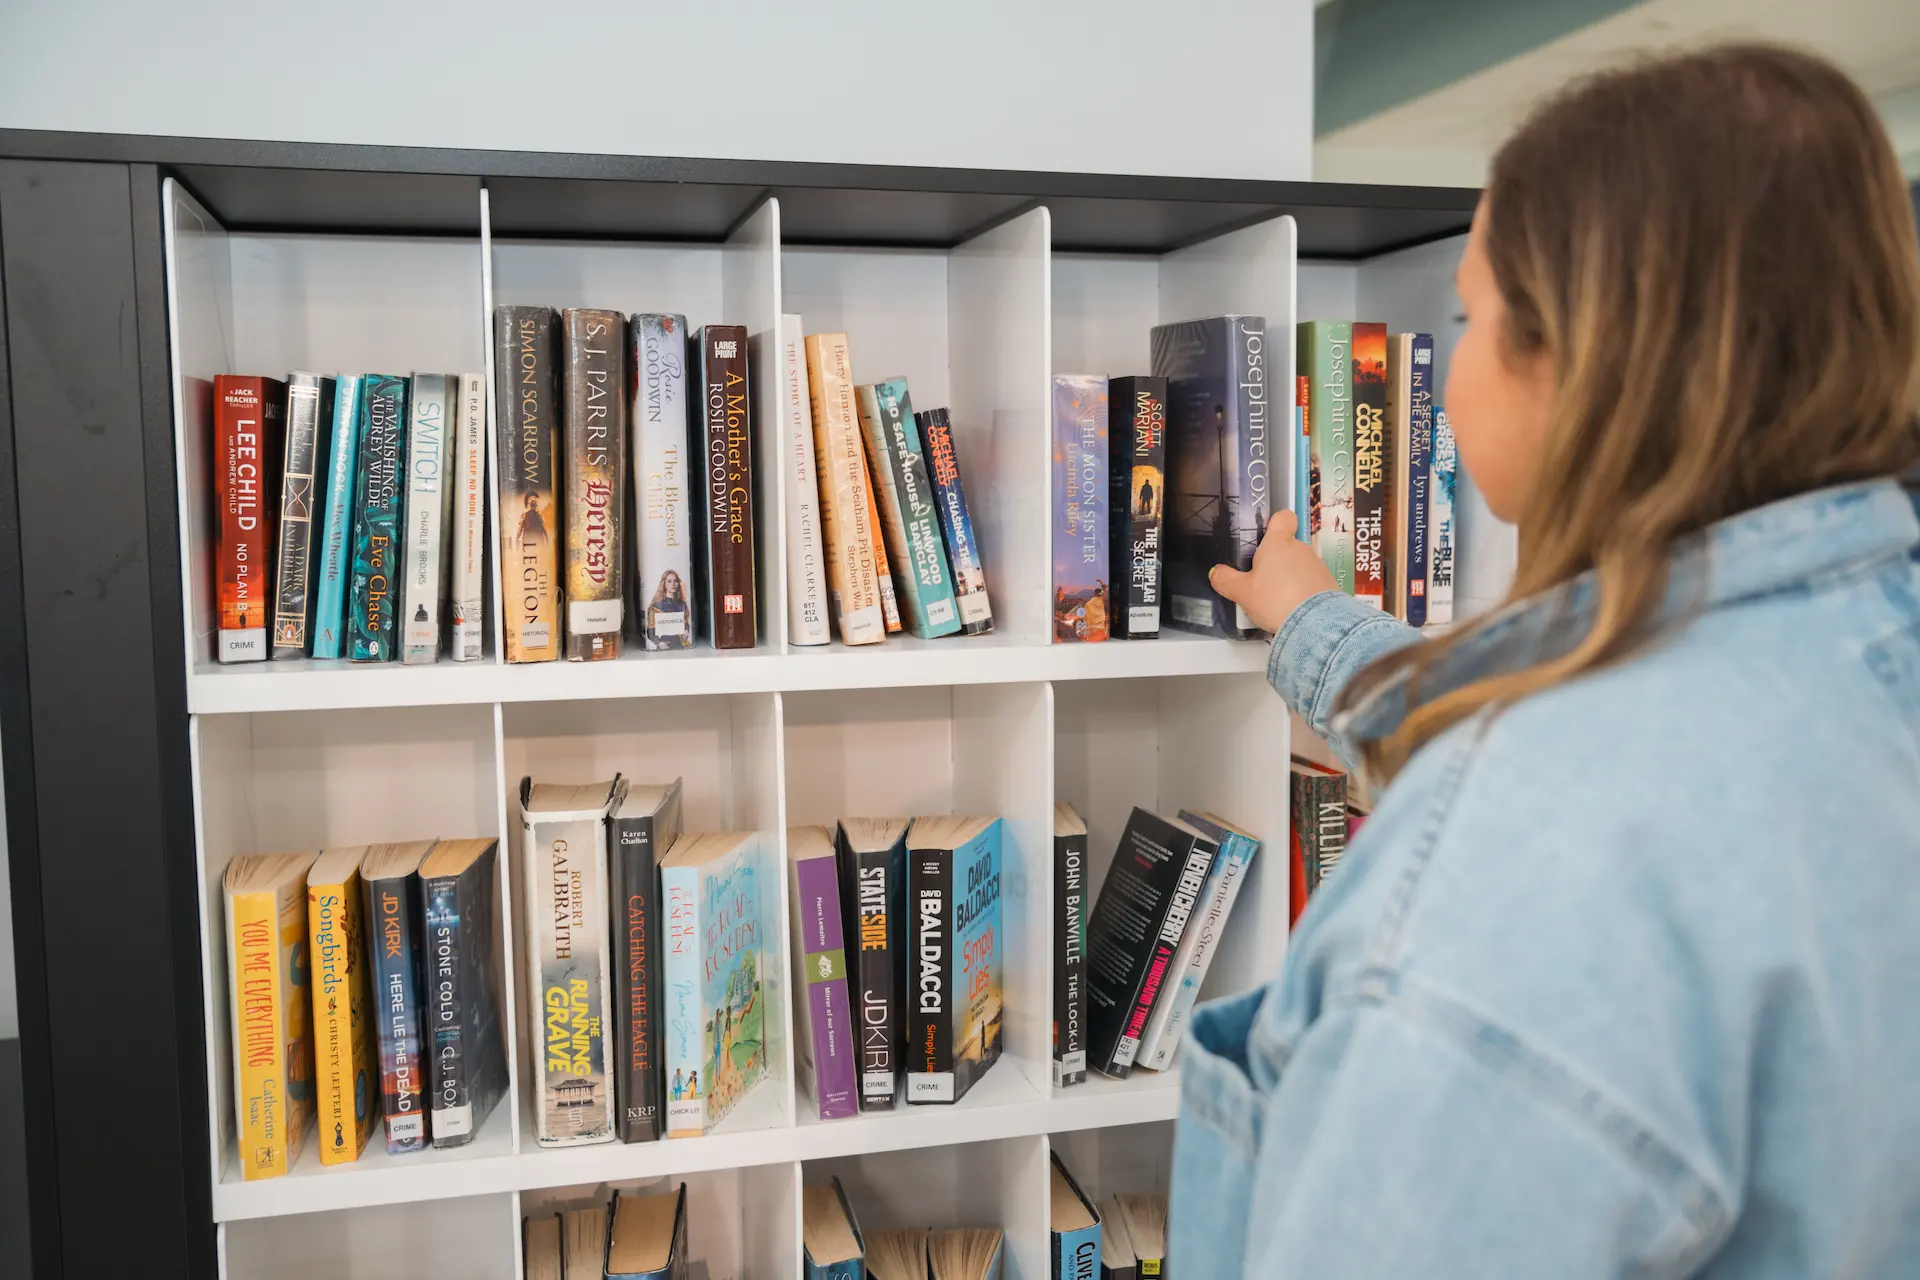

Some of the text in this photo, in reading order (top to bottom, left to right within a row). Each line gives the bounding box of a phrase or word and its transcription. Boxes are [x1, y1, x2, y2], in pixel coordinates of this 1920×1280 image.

[714, 341, 737, 350] LARGE
[715, 350, 737, 358] PRINT
[787, 342, 796, 365] THE
[225, 396, 258, 404] REACHER
[519, 319, 539, 483] SIMON SCARROW
[584, 323, 608, 466] S. J. PARRIS
[646, 337, 662, 423] GOODWIN
[659, 352, 682, 404] Rosie
[789, 370, 801, 407] STORY
[470, 417, 478, 445] JAMES
[793, 412, 802, 428] OF
[1135, 391, 1151, 457] MARIANI
[1150, 402, 1162, 446] SCOTT
[1240, 324, 1268, 508] Josephine Cox
[1325, 334, 1350, 496] Josephine Cox
[1410, 372, 1422, 467] IN THE FAMILY
[1421, 391, 1431, 452] A SECRET
[1435, 411, 1446, 473] GROSS
[237, 419, 257, 531] LEE CHILD
[335, 452, 348, 493] ROCK
[368, 394, 385, 508] AUDREY WILDE
[381, 394, 397, 511] THE VANISHING OF
[415, 401, 441, 493] SWITCH
[469, 450, 477, 475] SLEEP
[709, 383, 728, 533] ROSIE GOODWIN
[726, 370, 748, 544] A Mother's Grace
[795, 444, 806, 483] HEART
[835, 345, 868, 553] Harry Hanson and the Seaham Pit
[886, 395, 919, 515] NO SAFE HOUSE
[927, 426, 951, 487] CONNELLY
[937, 426, 958, 479] MICHAEL
[1356, 403, 1371, 494] CONNELLY
[1370, 408, 1383, 488] MICHAEL
[229, 448, 237, 514] ANDREW CHILD
[468, 479, 477, 491] NO
[468, 493, 476, 517] MORE
[664, 444, 681, 547] The Blessed
[1064, 443, 1080, 537] Lucinda Riley
[1082, 416, 1096, 564] THE MOON SISTER
[418, 511, 429, 585] CHARLIE BROOKS
[581, 479, 613, 583] Heresy
[946, 492, 967, 545] CHASING
[1356, 517, 1369, 572] HOURS
[1369, 507, 1382, 581] THE DARK
[1414, 503, 1428, 563] andrews
[1439, 519, 1450, 548] THE
[237, 543, 248, 611] NO PLAN B
[293, 556, 305, 591] DARK
[327, 531, 342, 582] Wheatle
[800, 504, 817, 602] RACHEL CLARKE
[847, 545, 858, 588] Stephen
[909, 521, 932, 587] BARCLAY
[919, 518, 943, 585] LINWOOD
[1133, 540, 1145, 590] SECRET
[1143, 527, 1158, 603] THE TEMPLAR
[1432, 547, 1442, 588] ZONE
[1440, 548, 1452, 587] BLUE
[368, 536, 388, 631] Eve Chase
[522, 542, 539, 624] LEGION
[539, 572, 548, 598] THE
[229, 641, 255, 649] CRIME
[621, 837, 648, 845] Charlton
[552, 839, 571, 960] GALBRAITH
[570, 870, 583, 928] ROBERT
[920, 890, 941, 898] DAVID
[956, 872, 1000, 933] BALDACCI
[968, 851, 992, 895] DAVID
[382, 891, 401, 959] JD KIRK
[859, 866, 887, 951] STATESIDE
[1066, 849, 1080, 998] JOHN BANVILLE THE
[1191, 862, 1239, 968] Danielle Steel
[316, 895, 342, 994] Songbirds
[437, 927, 453, 1021] STONE COLD
[920, 898, 941, 1013] BALDACCI
[963, 922, 995, 973] Simply
[241, 919, 275, 1067] YOU ME EVERYTHING
[628, 895, 648, 1072] CATCHING THE EAGLE
[969, 964, 991, 1001] Lies
[1139, 945, 1171, 1006] A THOUSAND
[390, 973, 411, 1112] HERE LIE THE DEAD
[546, 986, 571, 1073] GRAVE
[570, 979, 591, 1077] RUNNING
[589, 1015, 600, 1038] THE
[826, 1009, 832, 1017] of
[925, 1023, 937, 1056] Simply
[329, 1018, 342, 1119] CHRISTY LEFTERI
[443, 1079, 457, 1109] BOX
[916, 1083, 939, 1091] CRIME
[250, 1096, 262, 1126] Isaac
[263, 1078, 277, 1139] Catherine
[393, 1122, 417, 1132] CRIME
[627, 1105, 656, 1118] KRP
